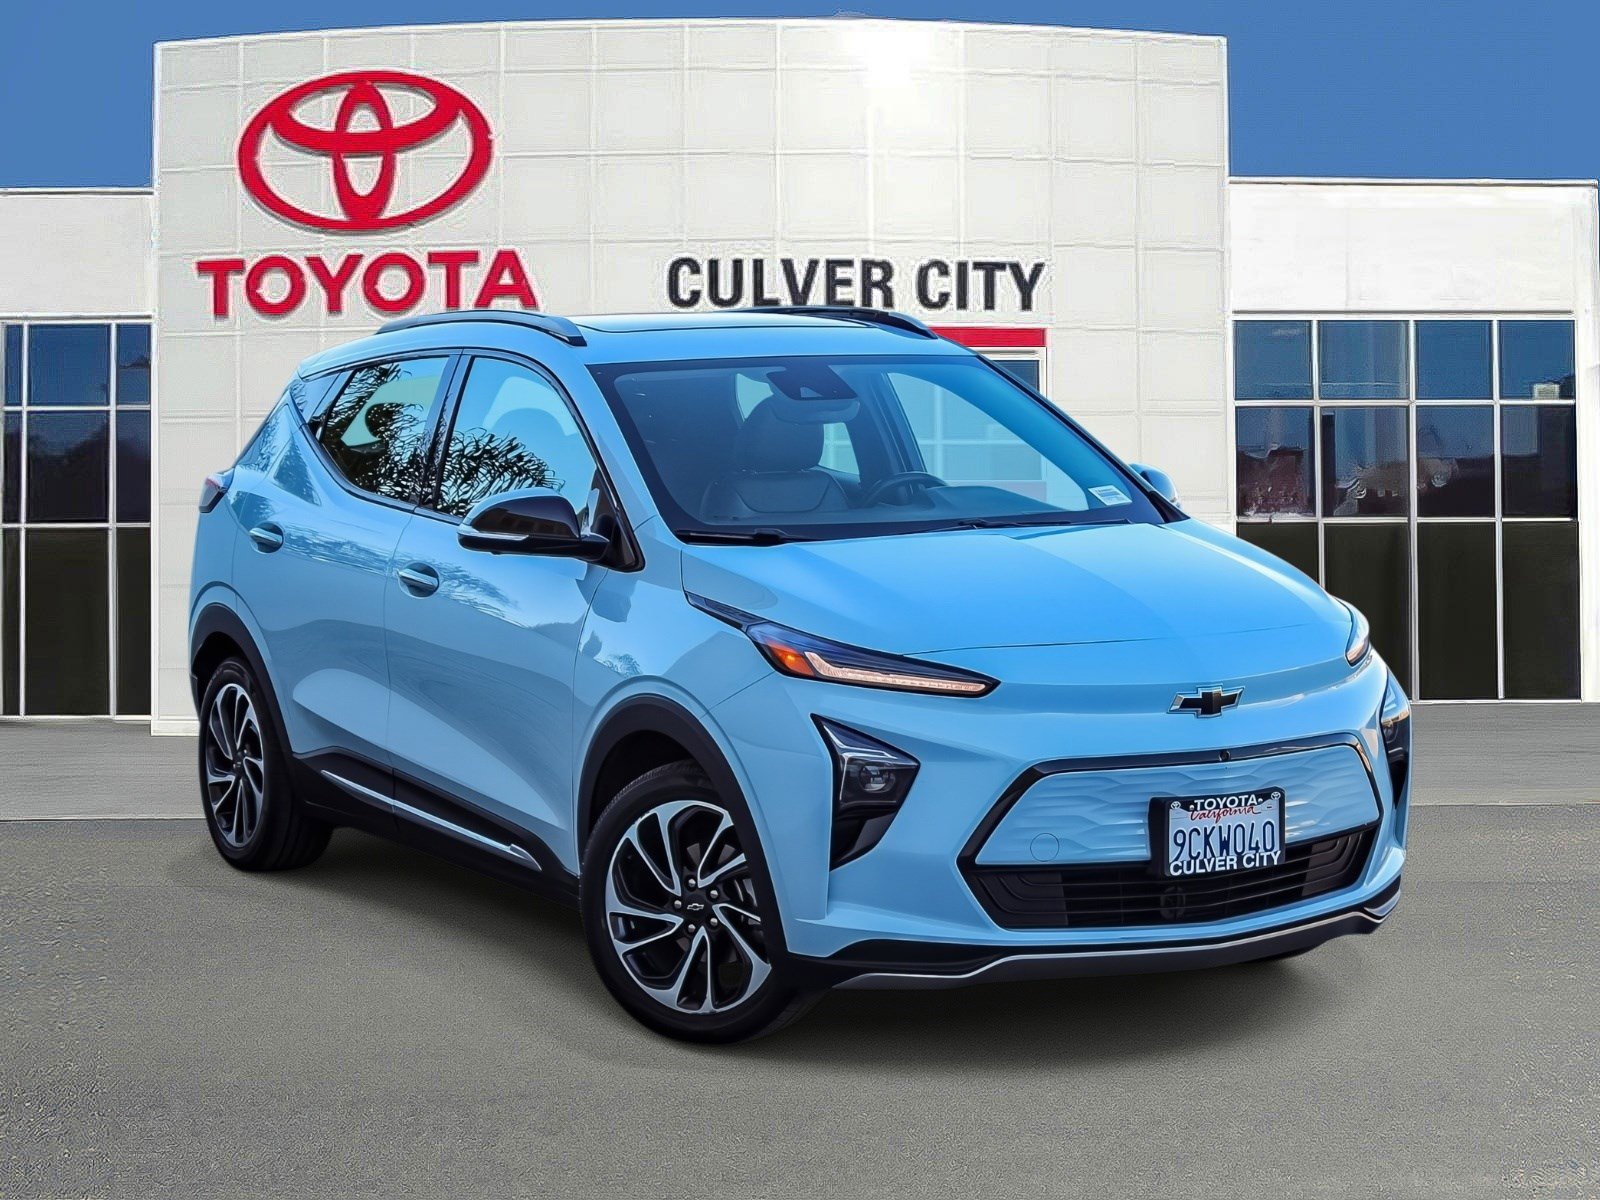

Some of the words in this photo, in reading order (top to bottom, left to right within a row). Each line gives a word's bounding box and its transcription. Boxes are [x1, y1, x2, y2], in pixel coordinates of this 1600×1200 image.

[196, 249, 539, 318] TOYOTA
[667, 257, 895, 308] CULVER
[916, 259, 1046, 311] CITY
[1190, 805, 1262, 824] California
[1194, 794, 1258, 811] TOYOTA
[1173, 820, 1275, 863] 9CKW040
[1169, 856, 1238, 876] CULVER
[1242, 850, 1282, 869] CITY
